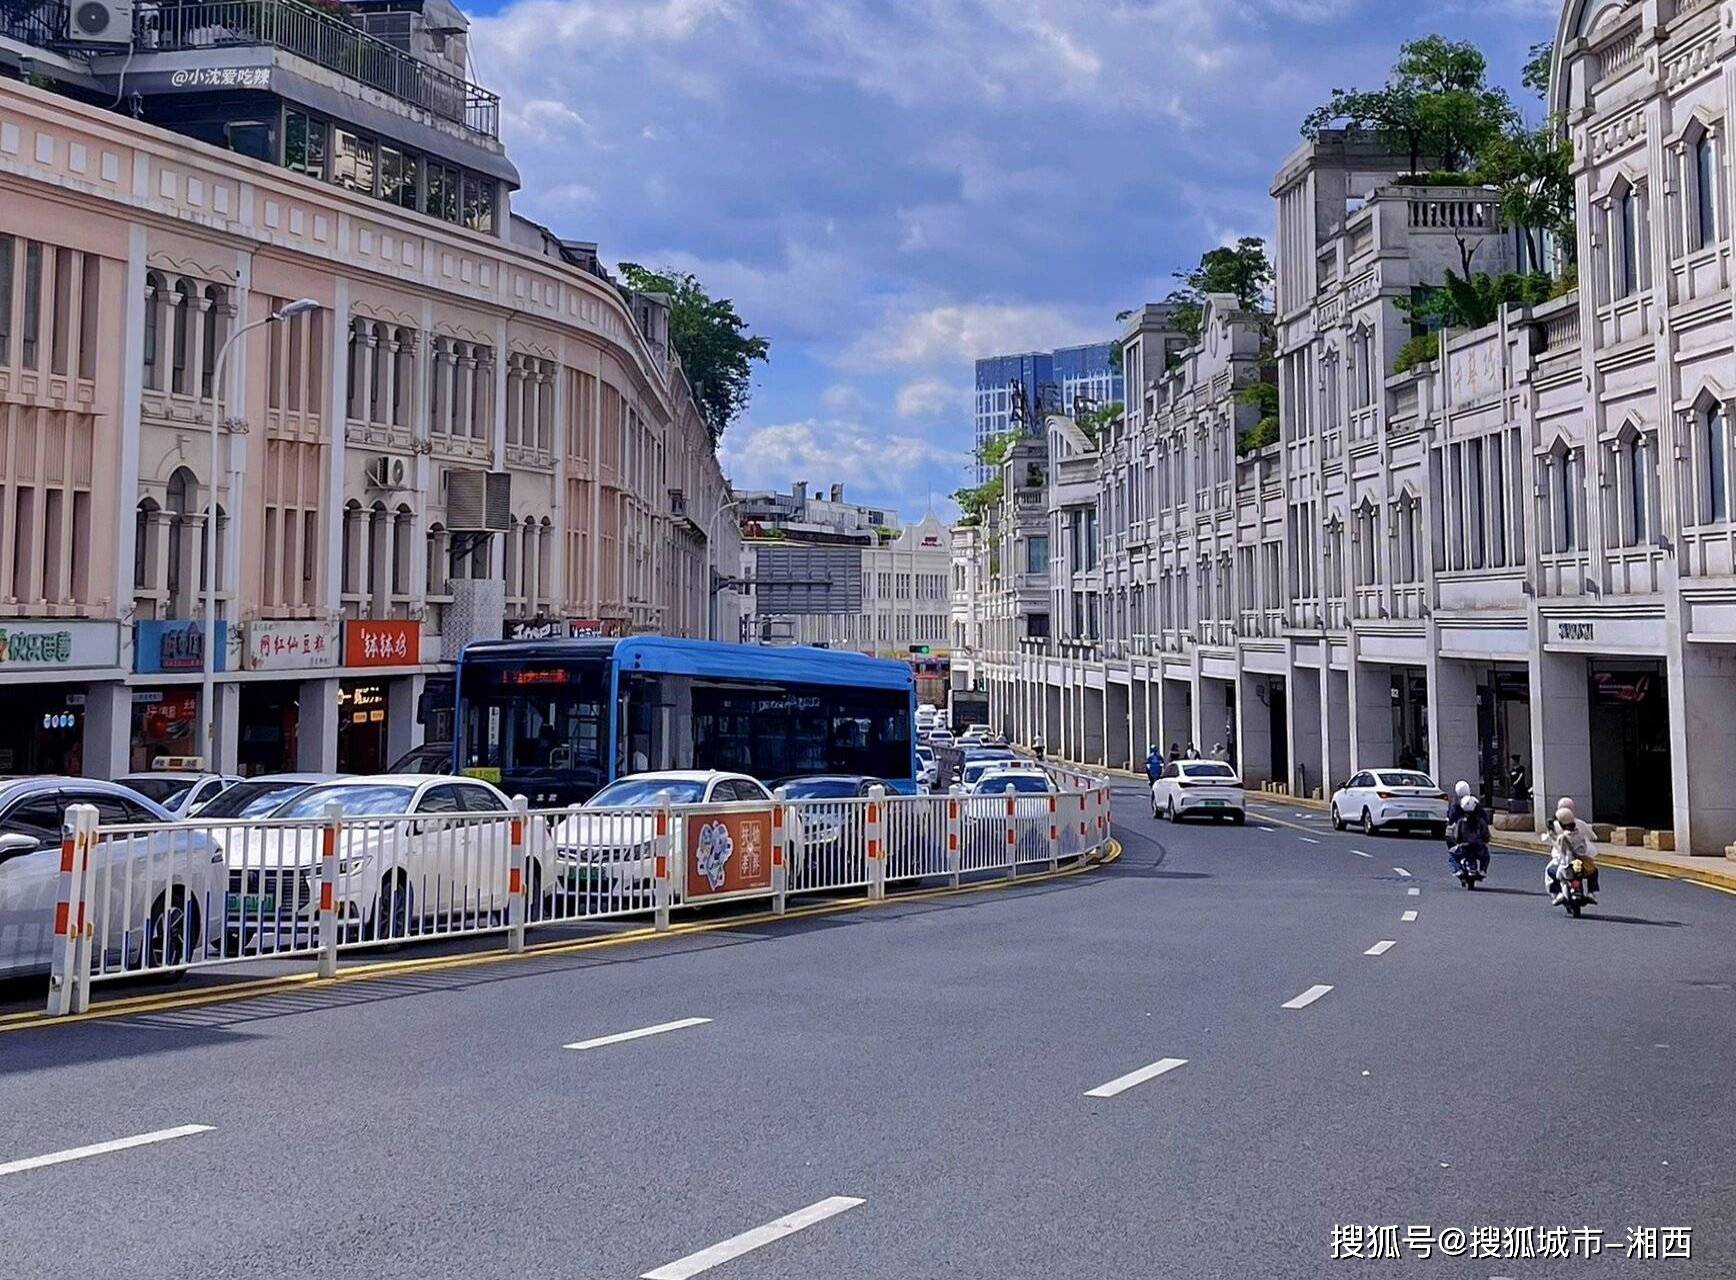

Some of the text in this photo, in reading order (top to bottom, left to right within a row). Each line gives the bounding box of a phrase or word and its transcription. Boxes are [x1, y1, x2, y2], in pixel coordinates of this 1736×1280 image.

[260, 633, 326, 657] 网红仙豆糕
[364, 629, 407, 659] 钵钵鸡
